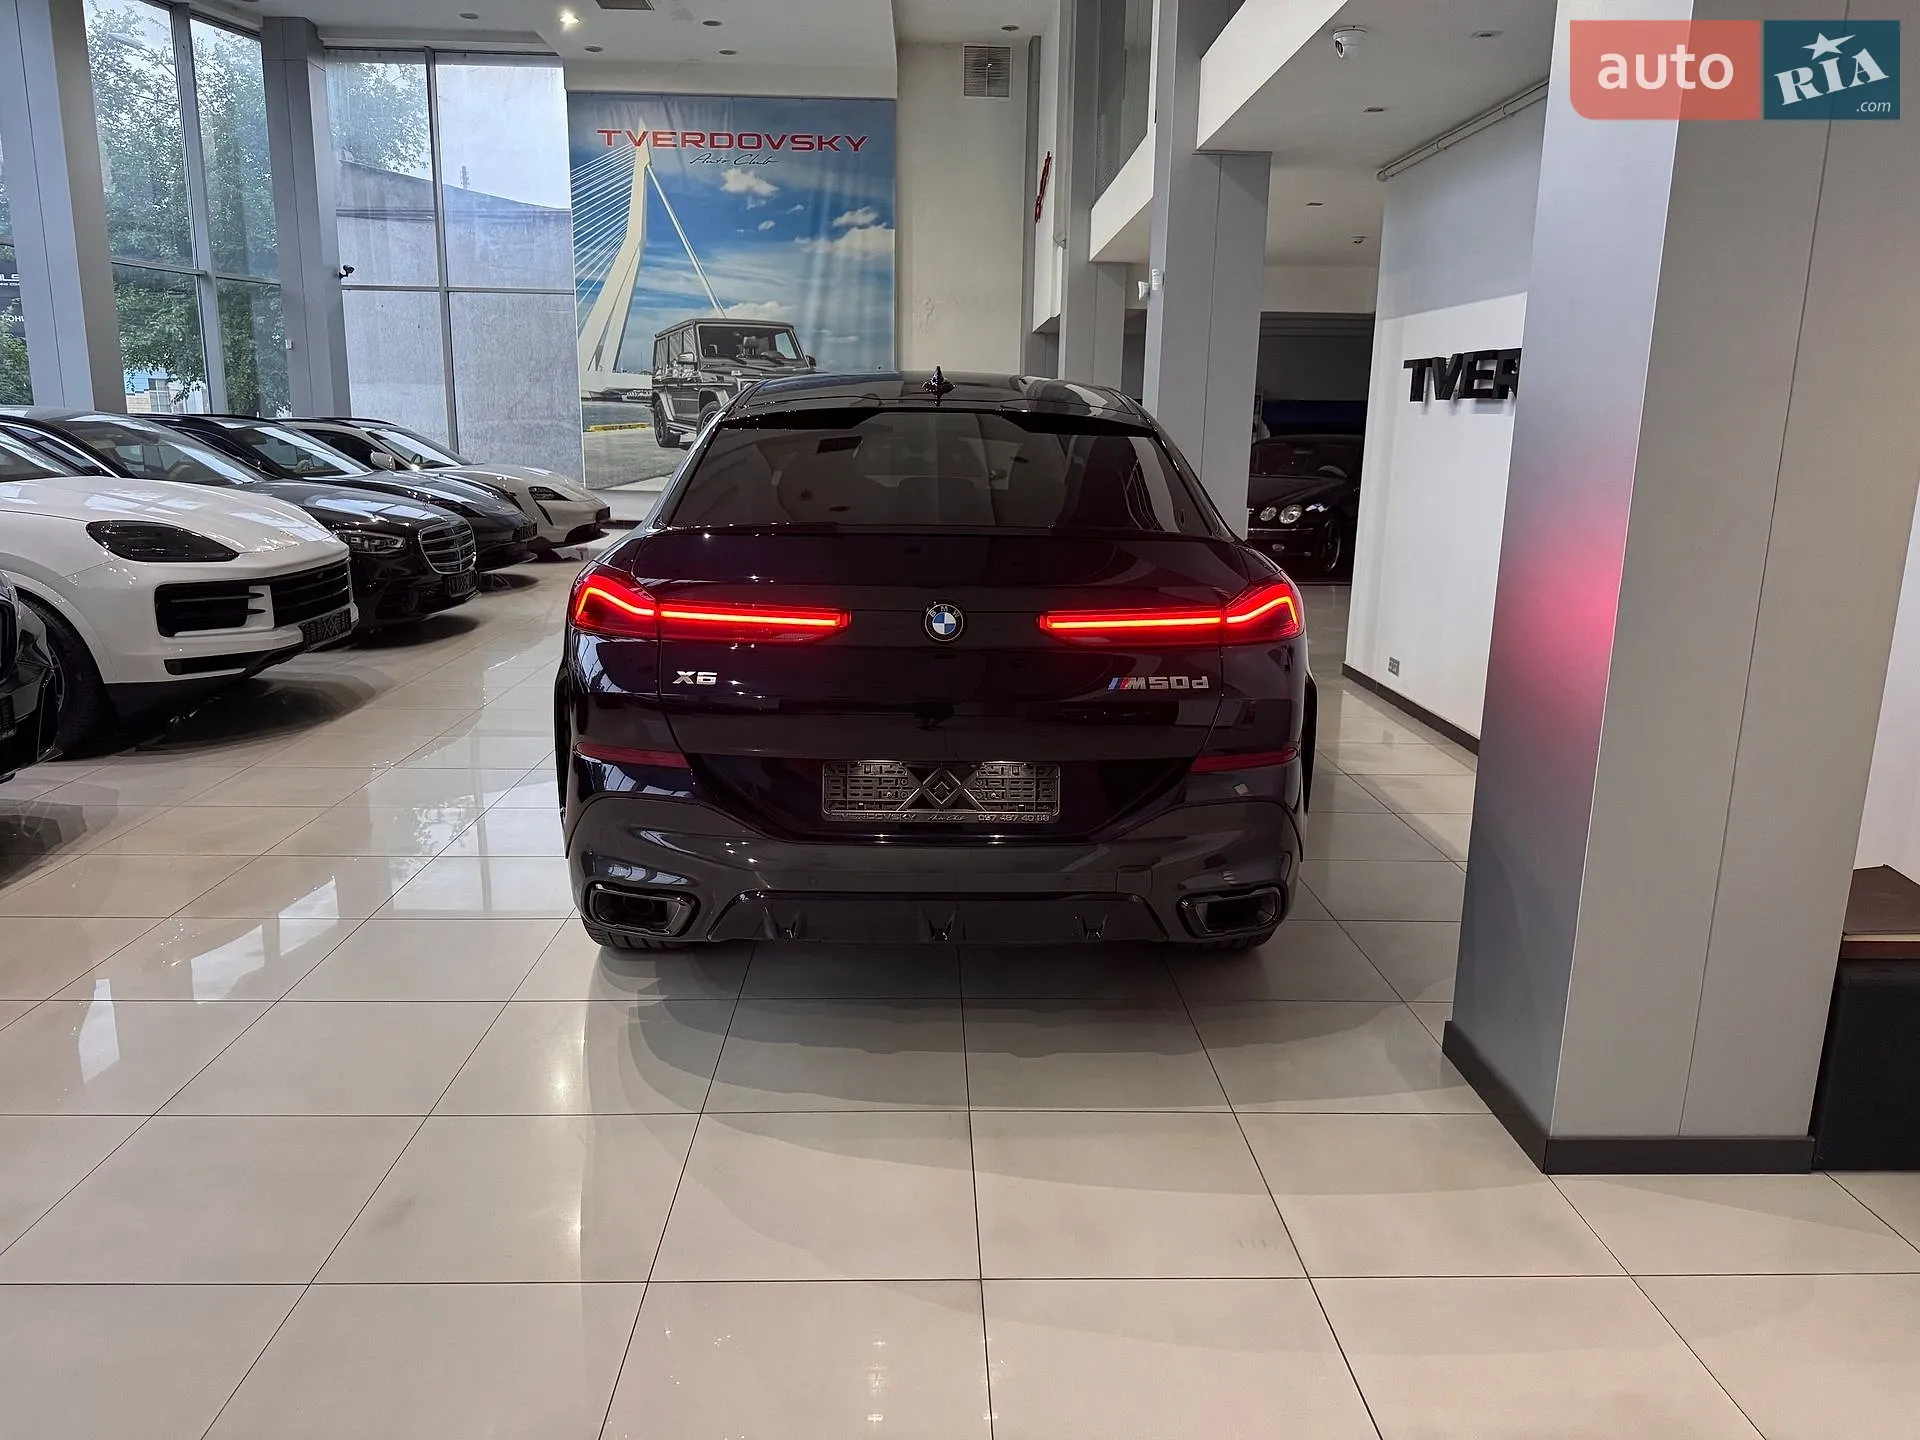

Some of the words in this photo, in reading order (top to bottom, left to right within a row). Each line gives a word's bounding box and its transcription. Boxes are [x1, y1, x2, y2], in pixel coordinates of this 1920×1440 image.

[596, 128, 868, 153] TVERDOVSKY
[689, 152, 730, 165] Auto
[733, 153, 777, 166] Club
[1402, 347, 1521, 402] TVER
[929, 605, 961, 618] BMW
[672, 670, 718, 685] X6
[1126, 675, 1210, 690] M50d
